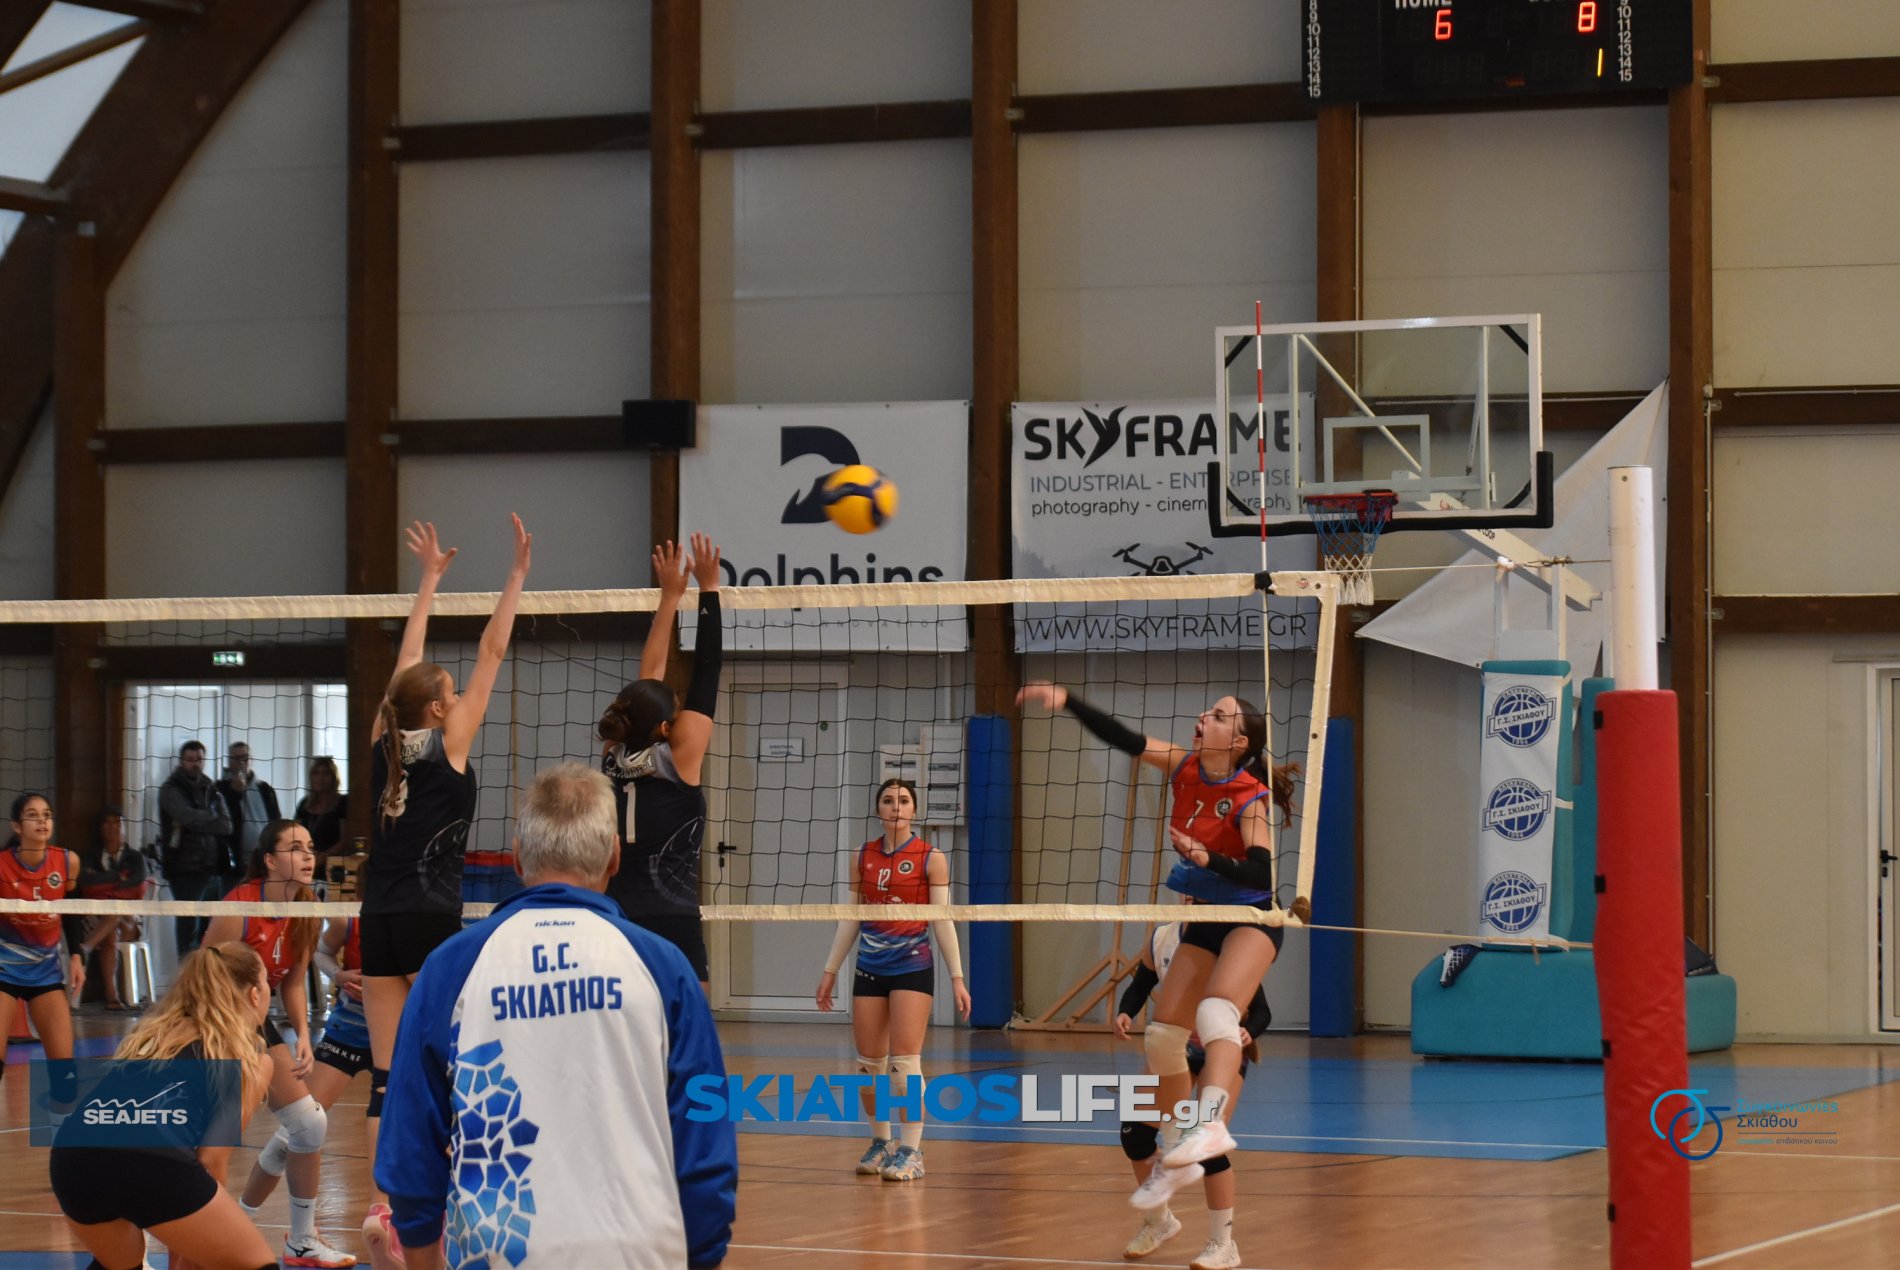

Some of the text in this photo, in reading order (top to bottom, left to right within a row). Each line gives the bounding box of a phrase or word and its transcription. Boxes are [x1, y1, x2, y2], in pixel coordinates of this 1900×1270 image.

[1309, 11, 1318, 23] 9
[1578, 2, 1596, 32] 8
[1617, 6, 1632, 18] 10
[1307, 23, 1321, 35] 10
[1435, 9, 1452, 40] 6
[1617, 18, 1632, 31] 11
[1307, 35, 1320, 48] 11
[1617, 31, 1632, 43] 12
[1307, 48, 1321, 60] 12
[1618, 44, 1632, 56] 13
[1307, 60, 1321, 72] 13
[1618, 56, 1633, 69] 14
[1307, 72, 1321, 85] 14
[1618, 69, 1633, 82] 15
[1307, 85, 1321, 98] 15
[1031, 474, 1151, 493] INDUSTRIAL
[1032, 498, 1140, 517] photography
[623, 781, 637, 843] 1
[1185, 800, 1204, 829] 7
[877, 868, 892, 891] 12
[272, 936, 281, 965] 4
[532, 942, 579, 973] G.C.
[491, 976, 623, 1021] SKIATHOS
